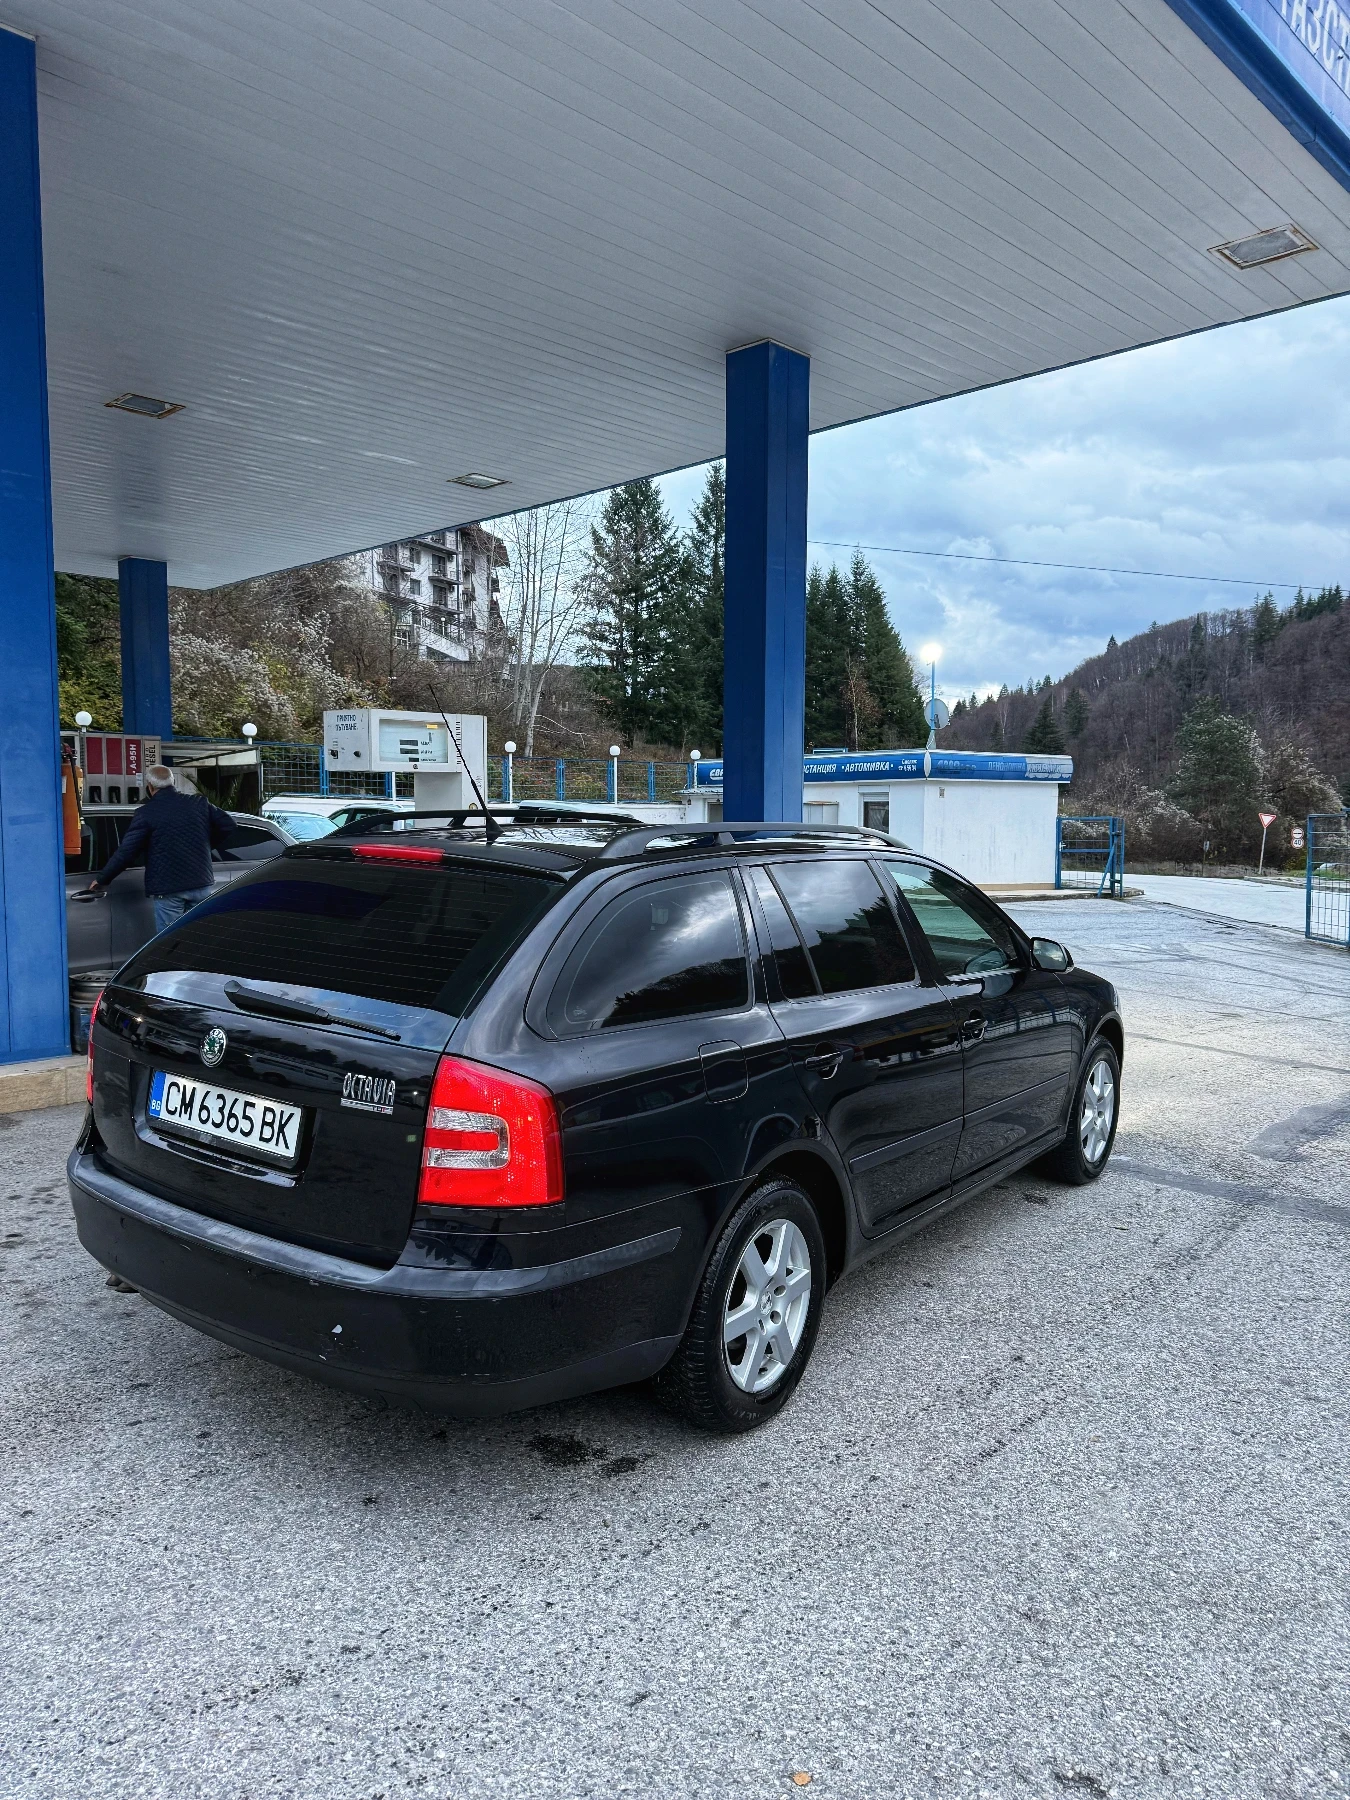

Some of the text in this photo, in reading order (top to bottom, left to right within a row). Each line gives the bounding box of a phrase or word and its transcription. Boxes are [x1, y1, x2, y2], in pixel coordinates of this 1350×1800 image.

[1281, 0, 1350, 92] АЗСТ
[803, 763, 837, 774] СТАНЦИЯ
[151, 1099, 161, 1111] BG
[342, 1072, 396, 1105] OCTAVIA
[165, 1081, 295, 1150] CM 6365 BK
